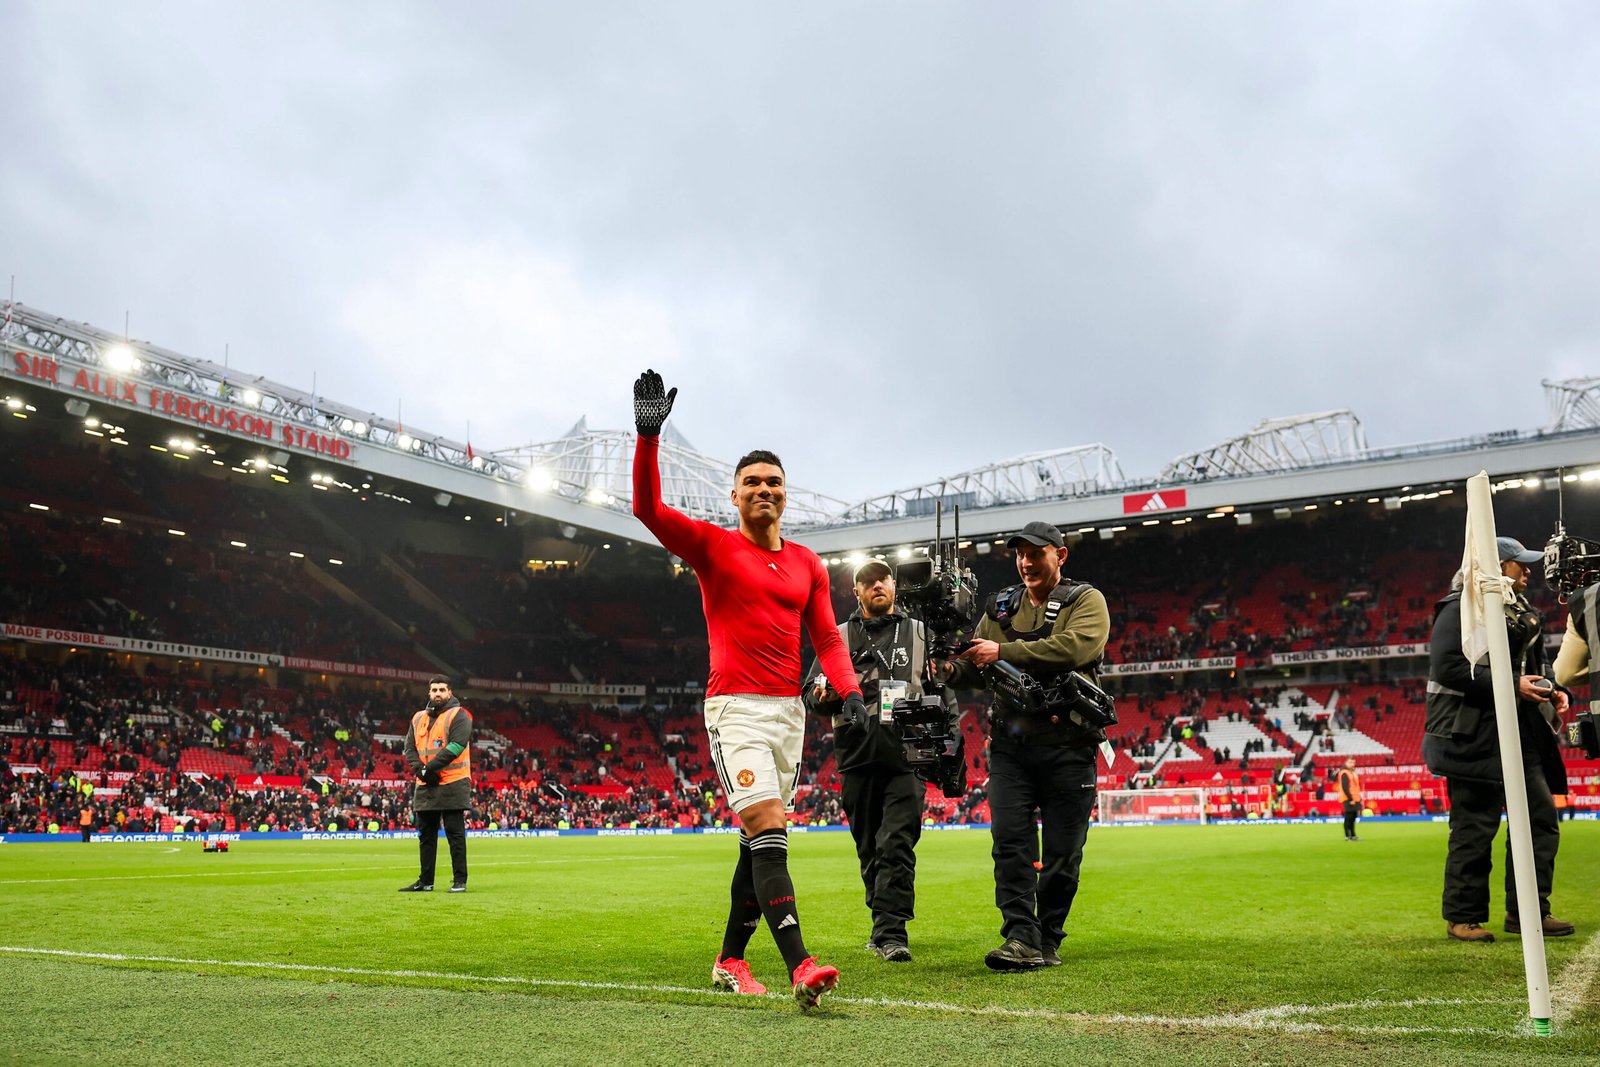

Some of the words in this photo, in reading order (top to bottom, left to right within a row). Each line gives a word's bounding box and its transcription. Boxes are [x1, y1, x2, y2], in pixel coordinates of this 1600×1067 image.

[15, 352, 58, 384] SIR
[73, 368, 138, 405] ALEX
[150, 389, 273, 440] FERGUSON
[282, 424, 350, 459] STAND
[5, 624, 42, 638] MADE
[1336, 645, 1390, 658] NOTHING
[1398, 645, 1415, 654] ON
[288, 657, 308, 668] EVERY
[310, 659, 333, 670] SINGLE
[334, 662, 347, 672] ONE
[357, 665, 366, 673] US
[1118, 662, 1152, 672] GREAT
[1158, 660, 1183, 670] MAN
[1188, 660, 1201, 668] HE
[1208, 658, 1233, 667] SAID
